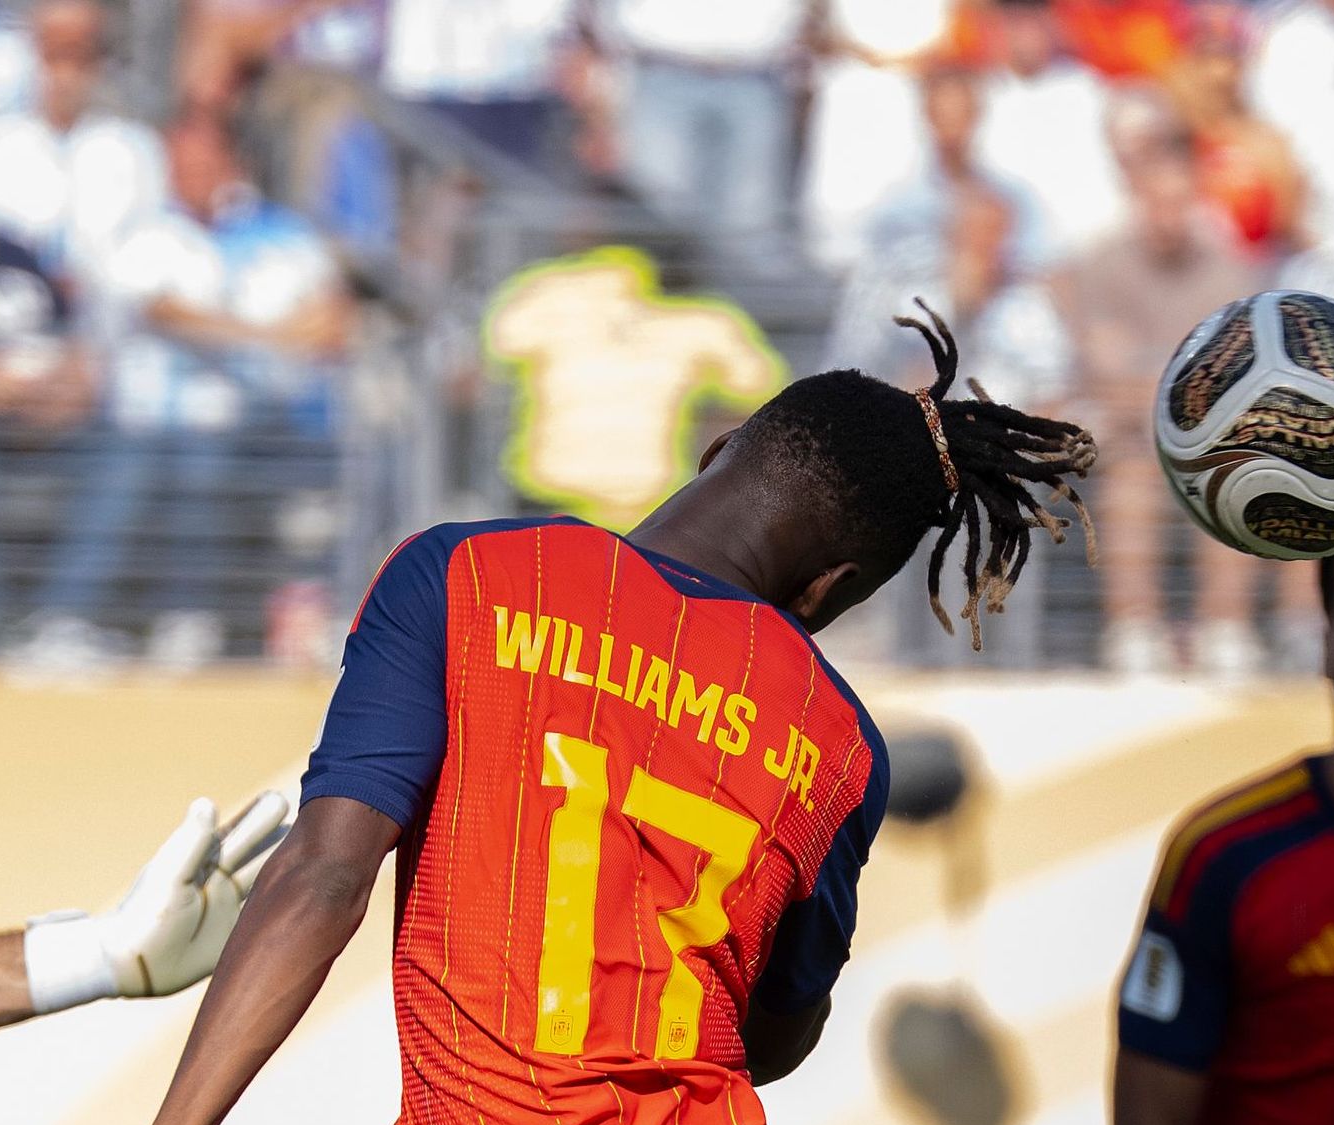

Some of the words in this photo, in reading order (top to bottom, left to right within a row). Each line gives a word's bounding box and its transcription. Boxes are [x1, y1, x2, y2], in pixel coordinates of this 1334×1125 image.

[494, 605, 758, 756] WILLIAMS
[764, 723, 815, 813] JR.
[533, 732, 761, 1061] 17
